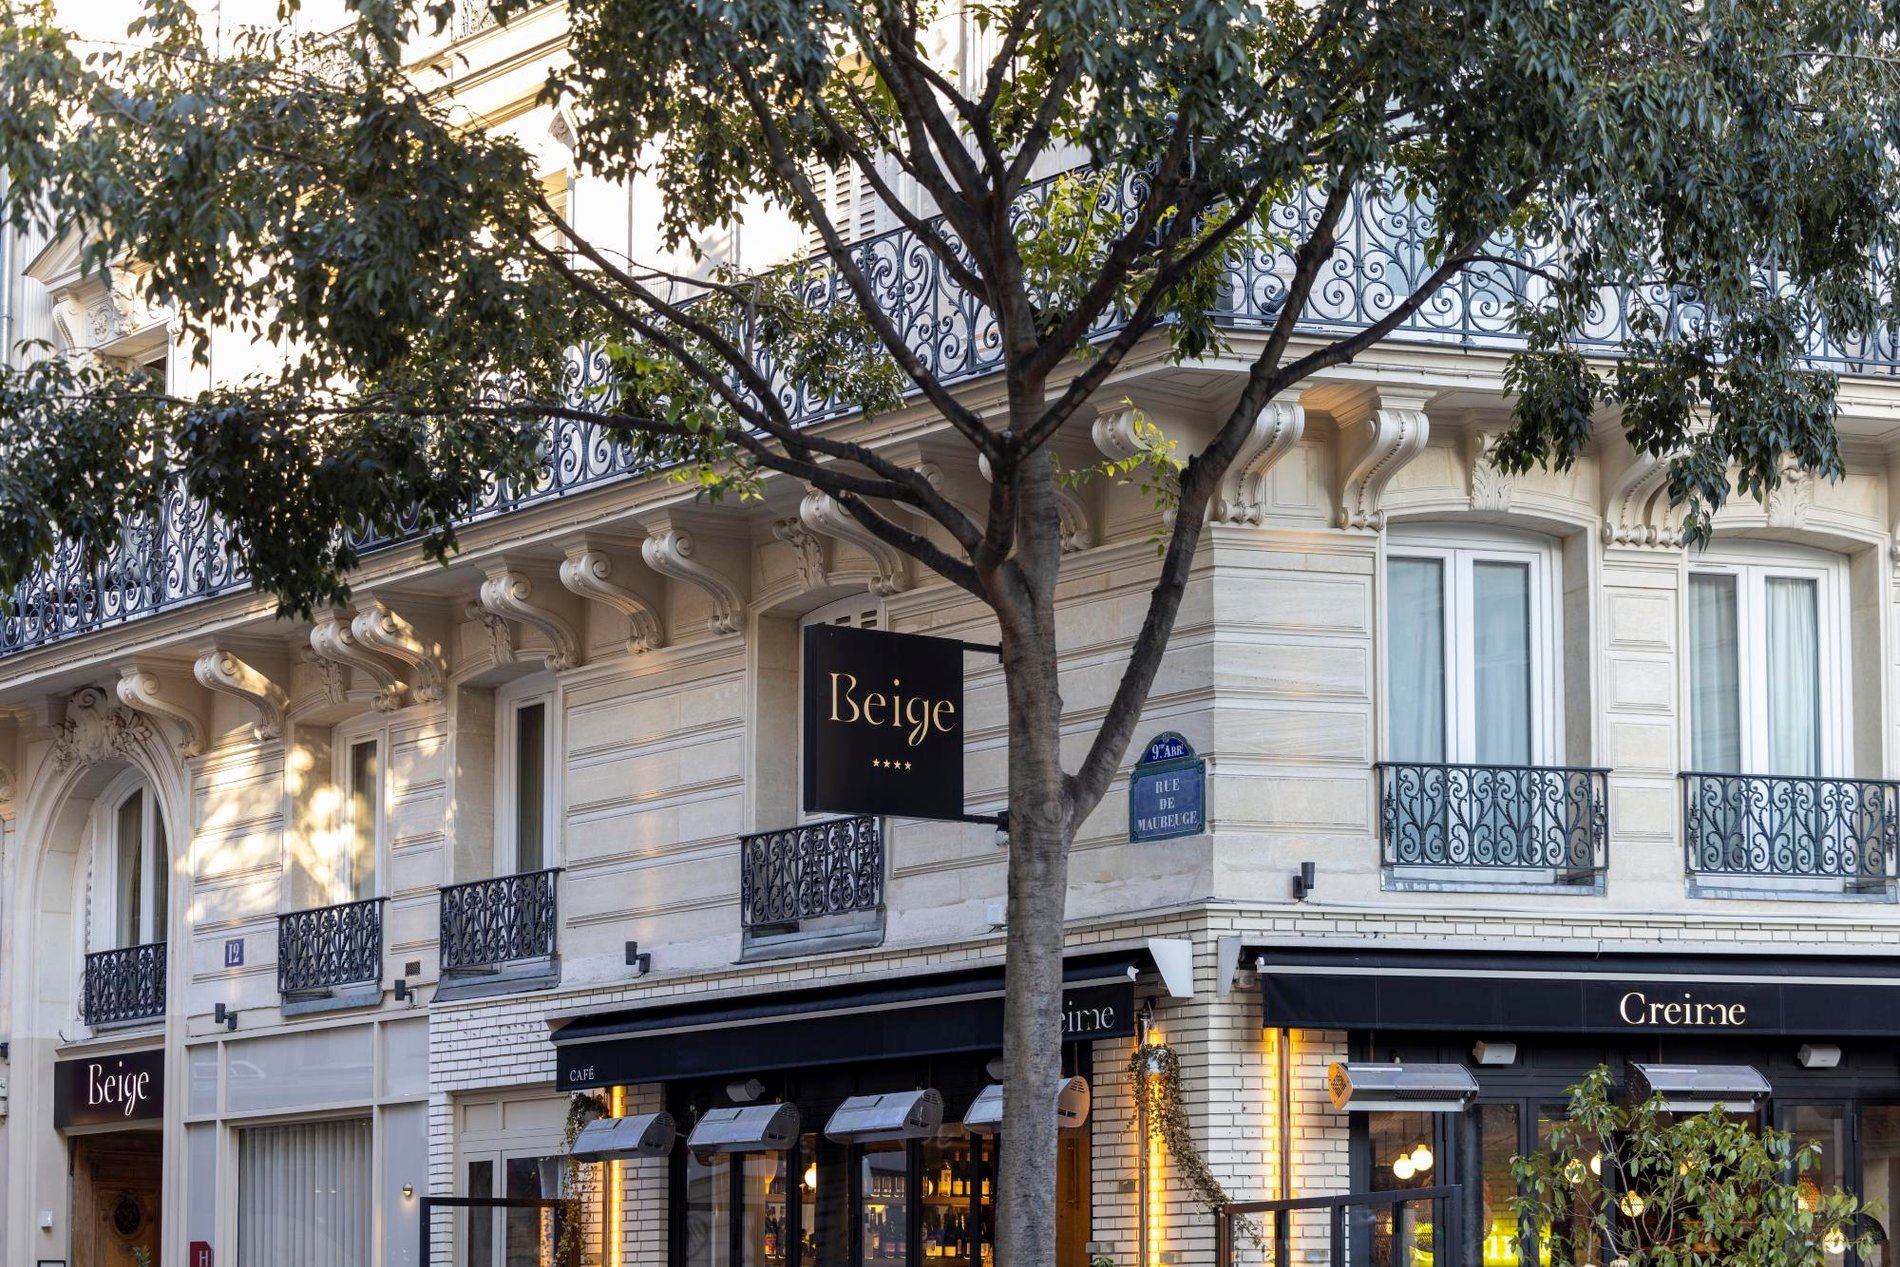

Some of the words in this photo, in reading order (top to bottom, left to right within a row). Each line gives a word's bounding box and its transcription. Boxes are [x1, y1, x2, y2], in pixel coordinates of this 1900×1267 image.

[828, 671, 956, 747] Beige
[1155, 778, 1180, 794] RUE
[1159, 797, 1175, 810] DE
[1137, 810, 1198, 832] MAUBEUGE
[228, 942, 240, 964] 12
[1619, 991, 1747, 1026] Creime
[569, 1065, 595, 1082] CAFÉ
[88, 1060, 150, 1117] Beige
[199, 1250, 209, 1267] H
